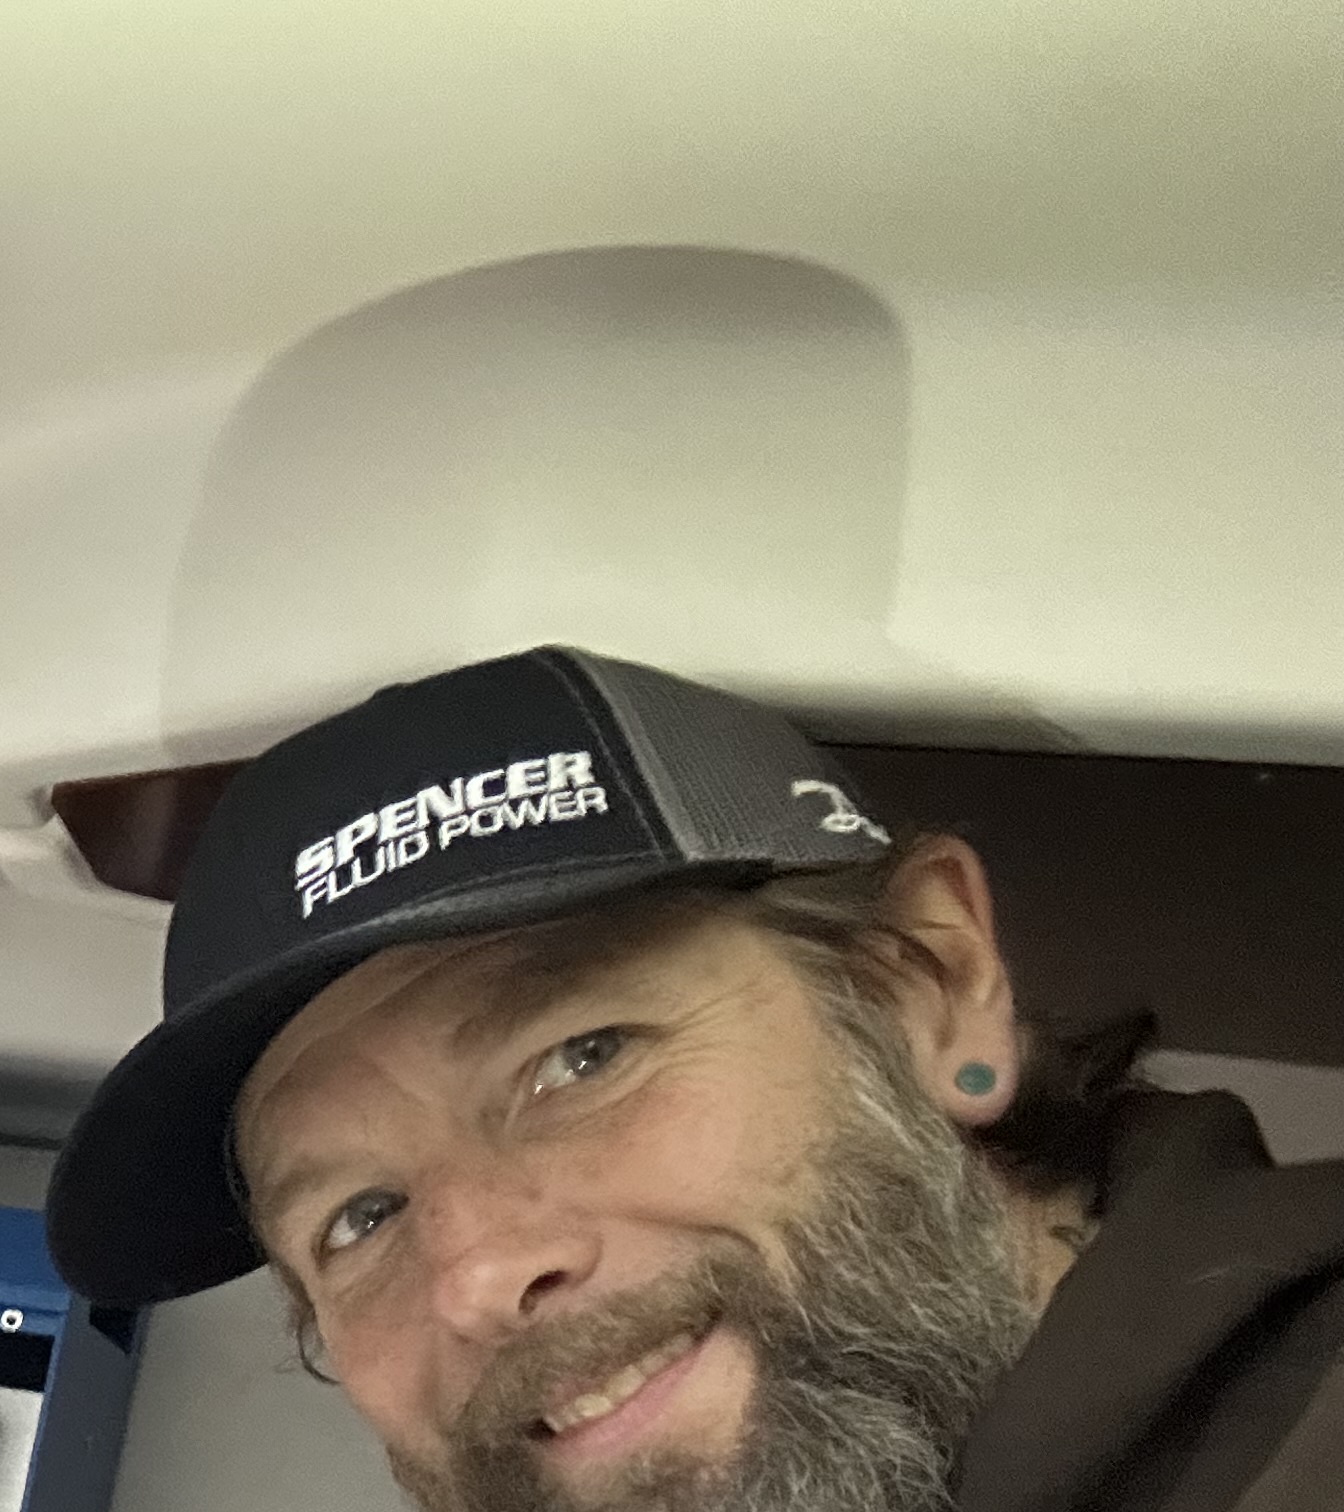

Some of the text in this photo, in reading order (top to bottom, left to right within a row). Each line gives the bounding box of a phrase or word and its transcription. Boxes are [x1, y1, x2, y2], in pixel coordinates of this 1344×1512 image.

[294, 750, 595, 891] SPENCER
[301, 786, 608, 919] FLUID POWER
